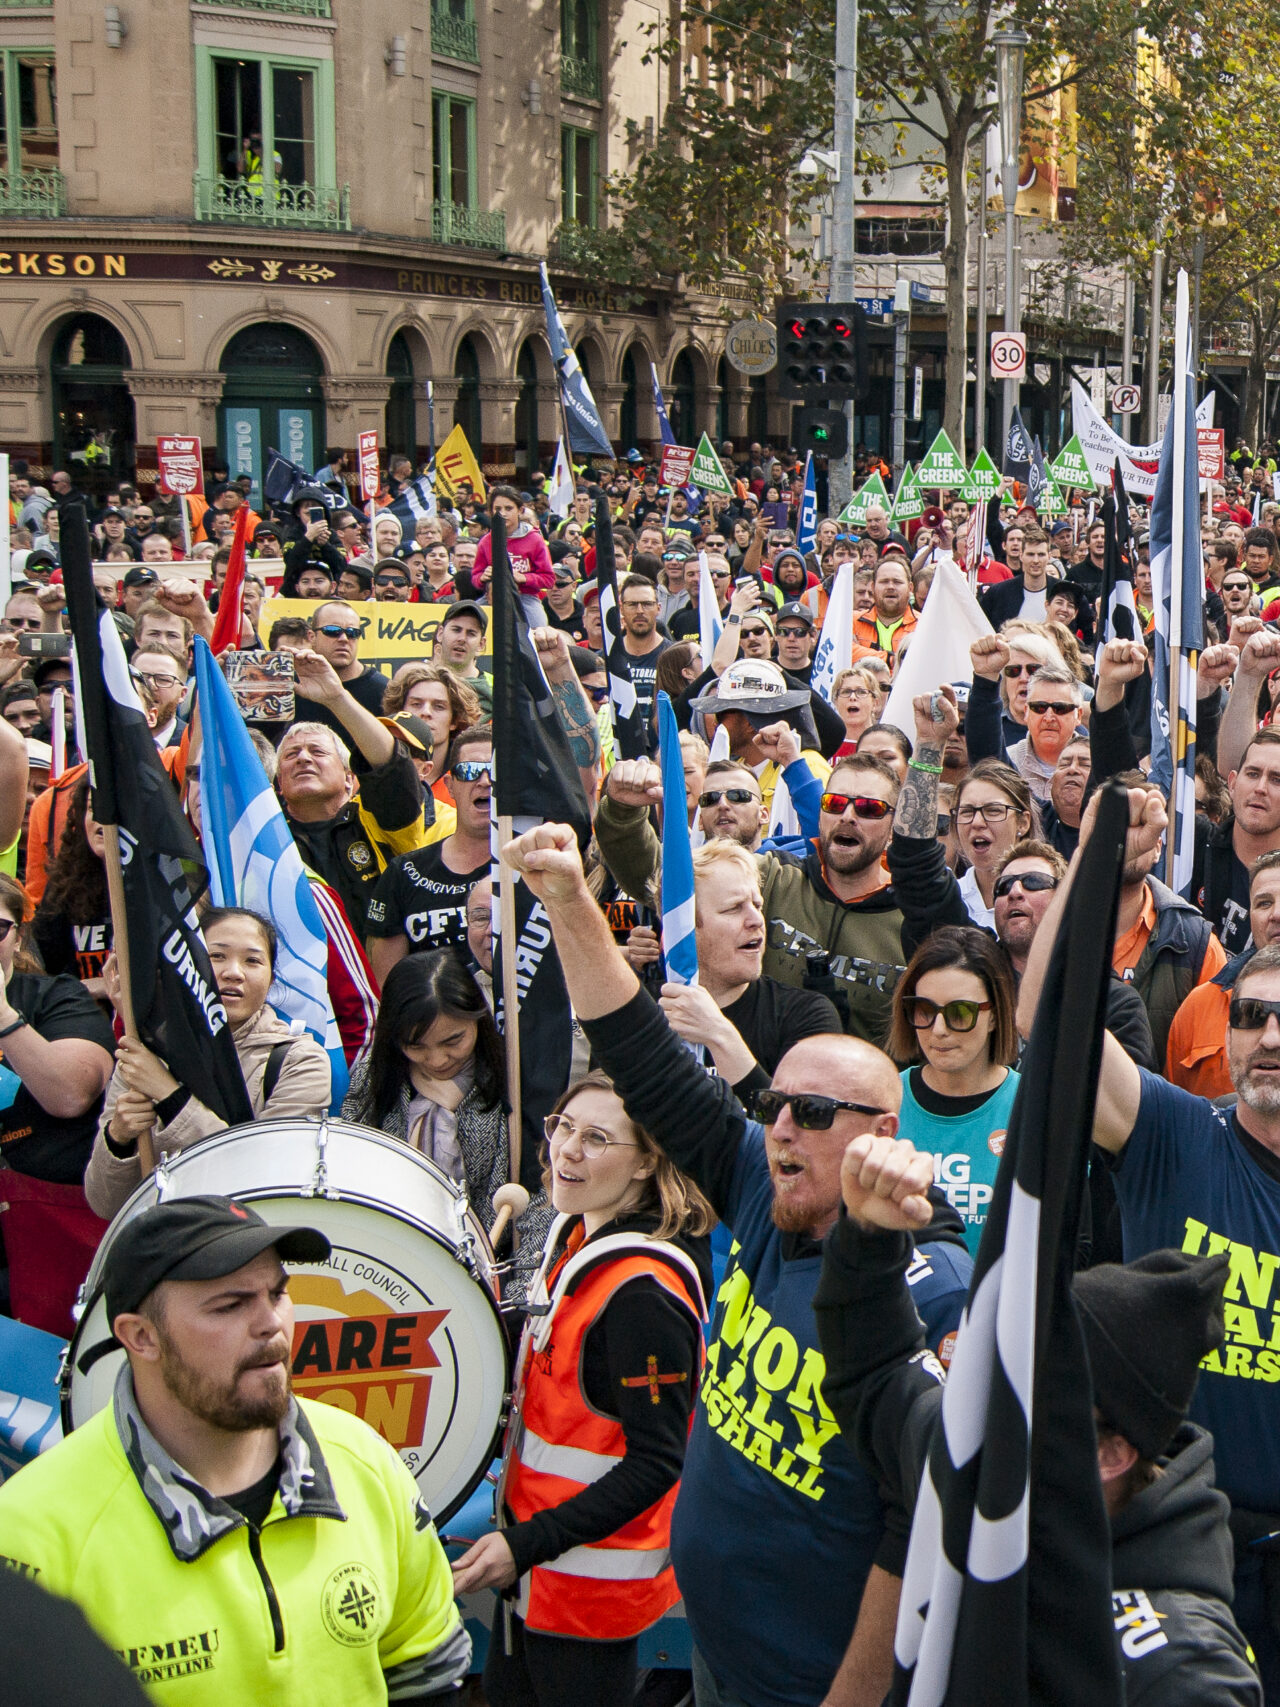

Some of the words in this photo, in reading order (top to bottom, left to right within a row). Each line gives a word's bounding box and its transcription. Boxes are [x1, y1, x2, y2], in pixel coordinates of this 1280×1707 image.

[1218, 74, 1234, 85] 214
[0, 253, 126, 276] CKSON
[397, 271, 487, 298] PRINCE'S
[500, 284, 562, 305] BRIDE
[997, 346, 1021, 365] 30
[575, 402, 599, 427] Union
[1089, 430, 1098, 439] To
[698, 454, 716, 472] THE
[931, 452, 954, 467] THE
[1063, 452, 1082, 468] THE
[691, 468, 725, 489] GREENS
[918, 468, 965, 483] GREENS
[974, 470, 994, 484] THE
[1052, 465, 1089, 484] GREENS
[1095, 463, 1135, 480] HOUR
[1138, 476, 1155, 486] THE
[862, 491, 883, 506] THE
[903, 487, 915, 499] THE
[896, 500, 921, 516] GREENS
[378, 617, 440, 642] WAG
[403, 861, 420, 881] GOD
[1, 1126, 32, 1143] nions
[353, 1263, 411, 1306] COUNCIL
[701, 1368, 826, 1501] SHALL
[333, 1566, 362, 1583] CFMEU
[137, 1656, 215, 1684] ONTLINE
